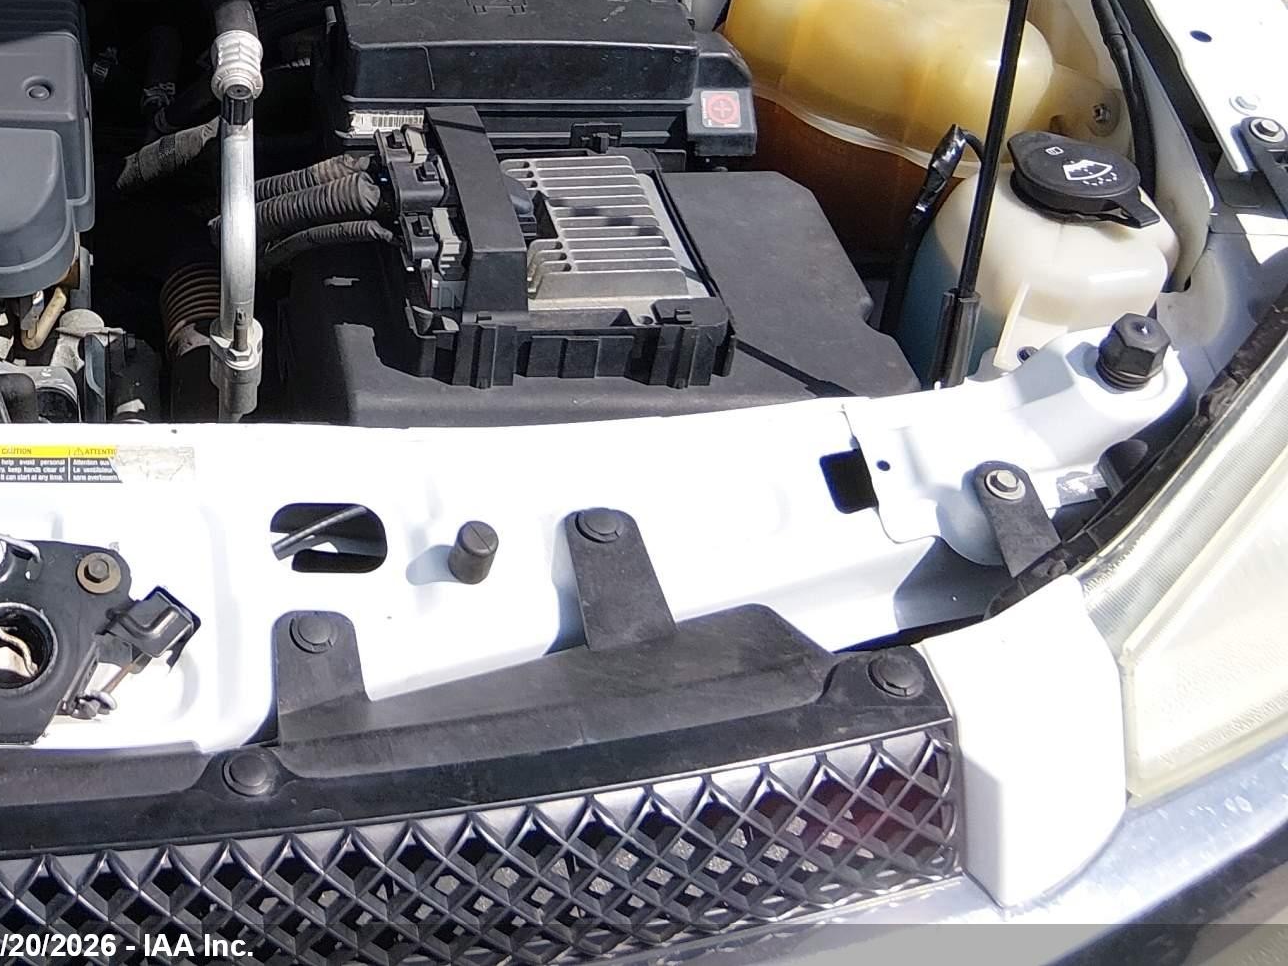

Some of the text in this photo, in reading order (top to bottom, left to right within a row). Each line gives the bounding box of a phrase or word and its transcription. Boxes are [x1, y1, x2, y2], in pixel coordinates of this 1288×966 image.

[1, 447, 33, 456] CAUTION
[1, 458, 15, 467] help
[19, 458, 36, 466] avoid
[39, 458, 66, 467] personal
[7, 466, 22, 475] keep
[23, 466, 42, 474] hands
[42, 466, 58, 474] clear
[58, 466, 67, 474] of
[5, 474, 17, 482] can
[17, 474, 31, 482] start
[30, 474, 39, 482] at
[38, 474, 49, 483] any
